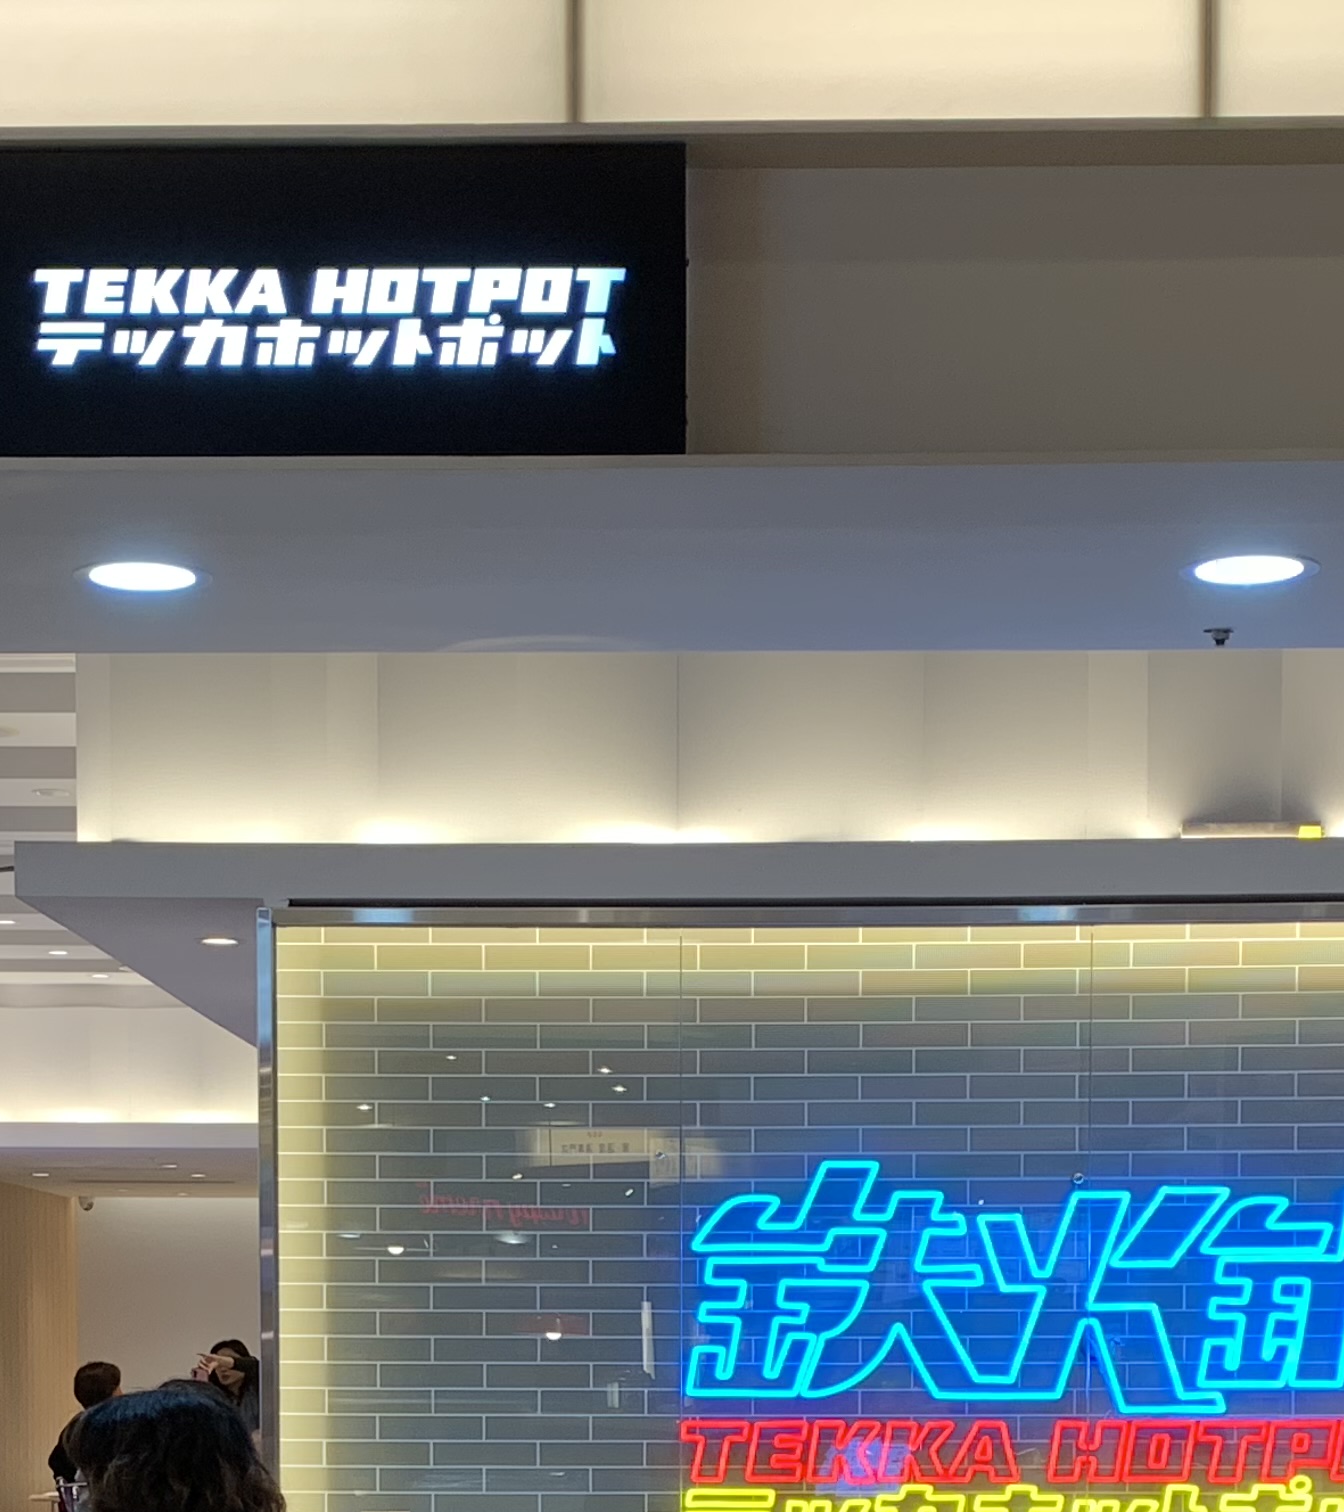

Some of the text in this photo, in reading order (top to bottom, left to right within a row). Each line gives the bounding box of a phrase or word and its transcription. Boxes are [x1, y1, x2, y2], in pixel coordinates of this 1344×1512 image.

[33, 266, 628, 317] TEKKA HOTPOT
[35, 312, 617, 368] テッカホットポット
[680, 1418, 1021, 1485] TEKKA
